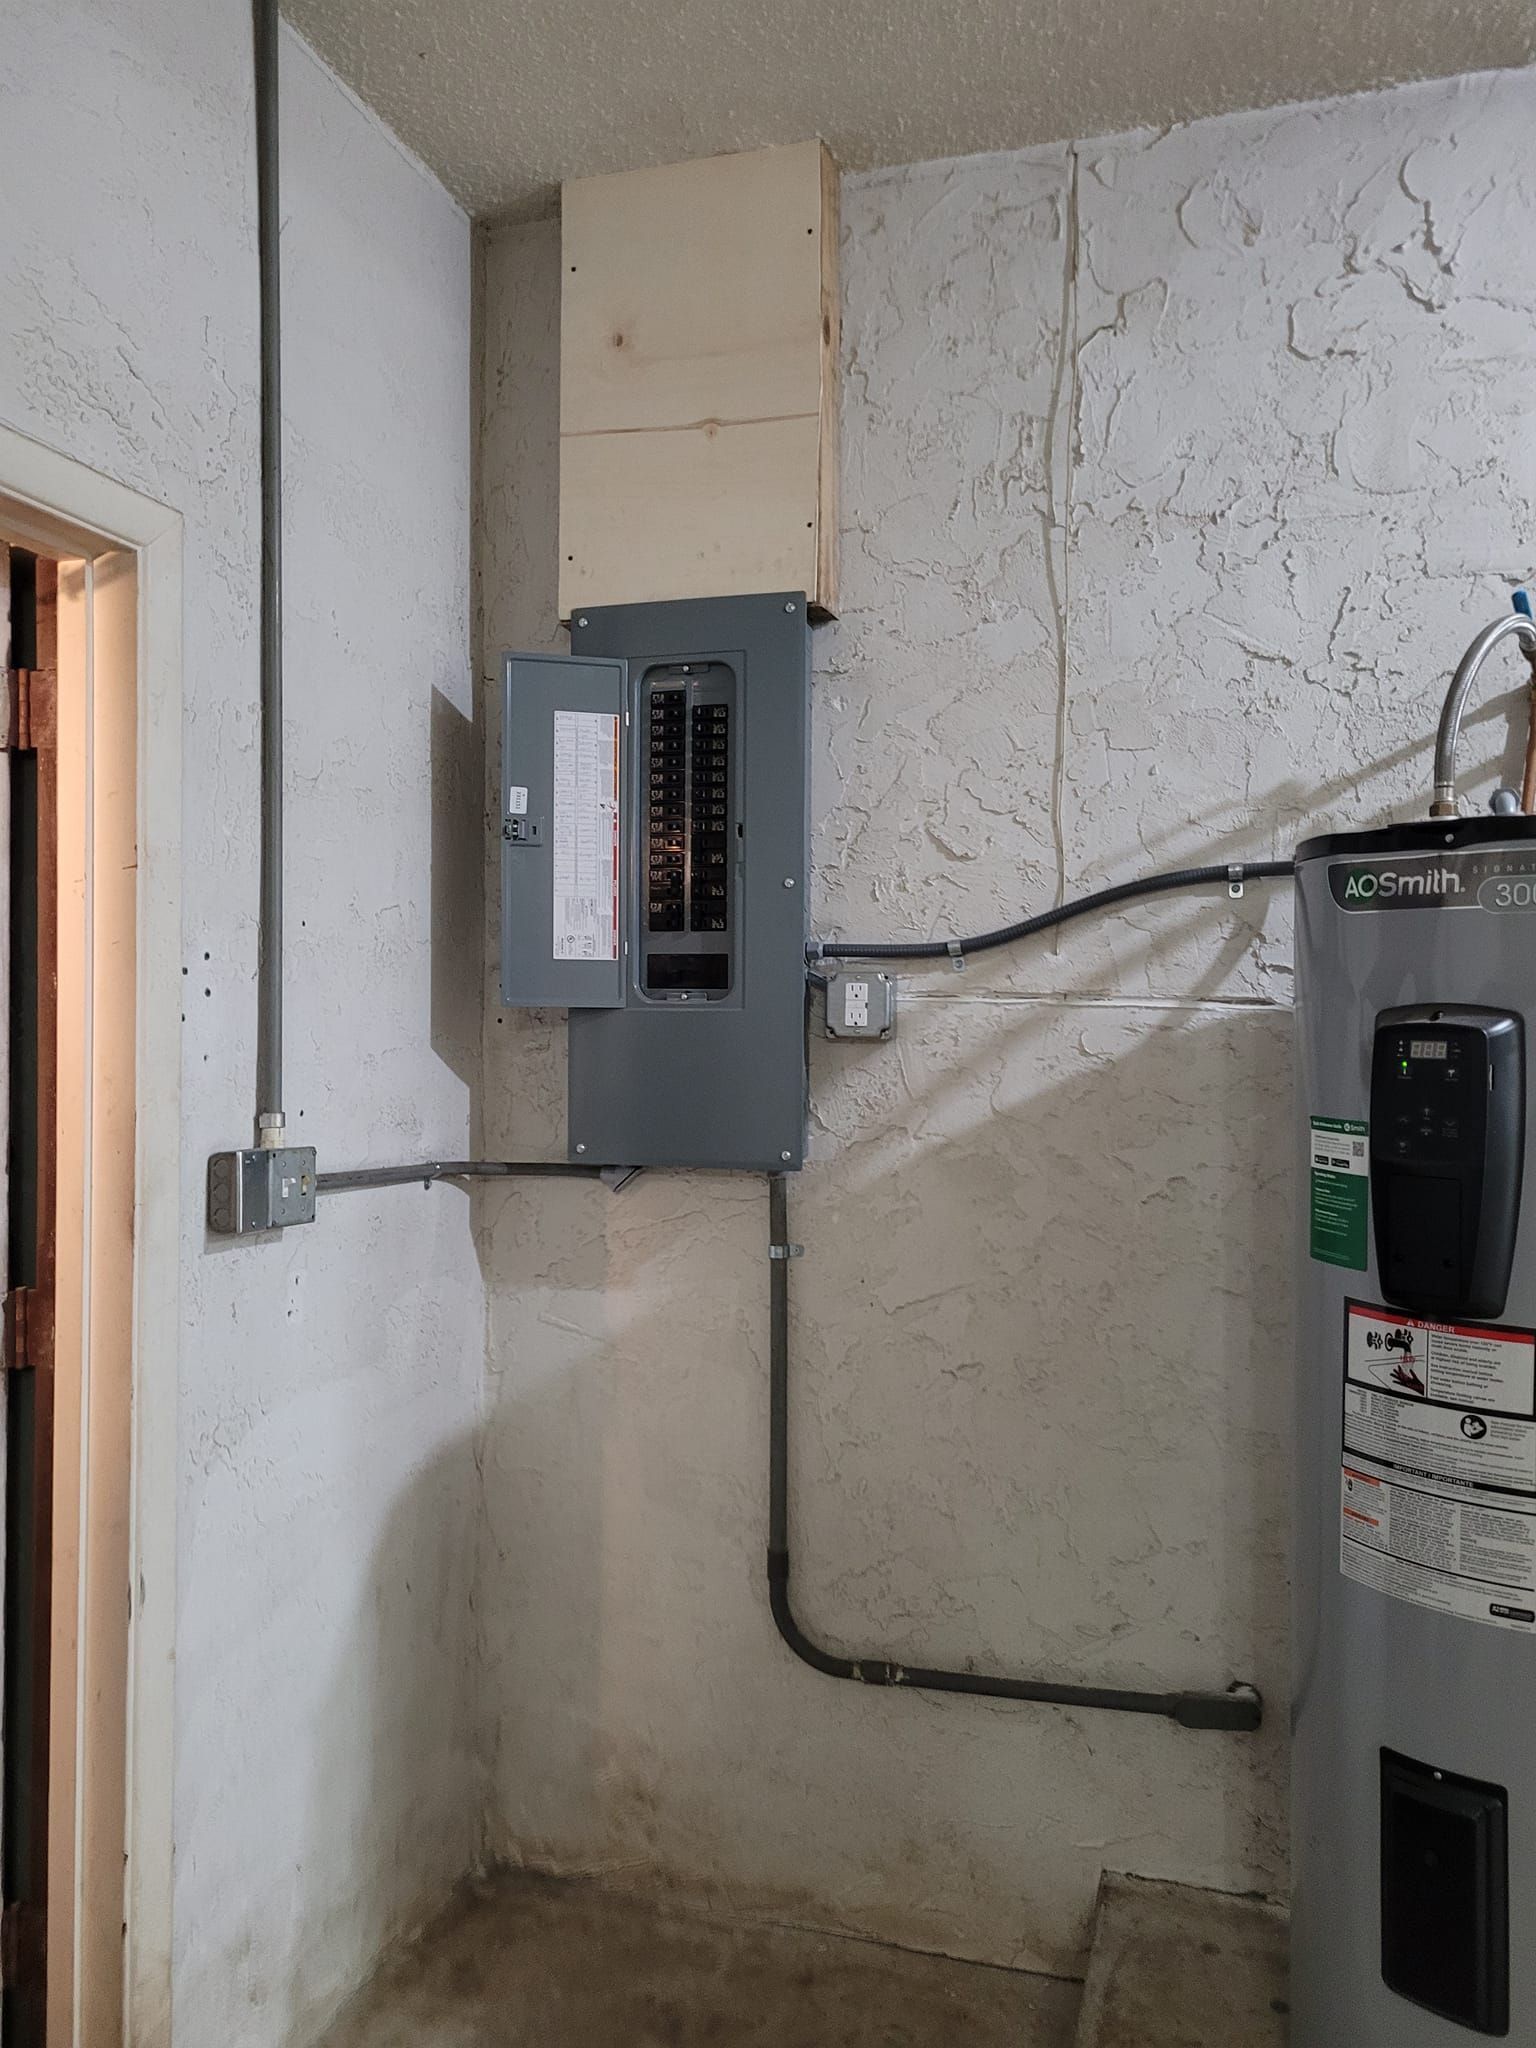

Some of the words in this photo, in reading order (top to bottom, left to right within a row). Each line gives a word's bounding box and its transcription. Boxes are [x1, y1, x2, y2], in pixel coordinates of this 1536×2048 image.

[1495, 882, 1536, 907] 30
[1417, 1320, 1455, 1333] DANGER
[1392, 1463, 1427, 1478] IMPORTANT
[1431, 1473, 1474, 1488] IMPORTANTE
